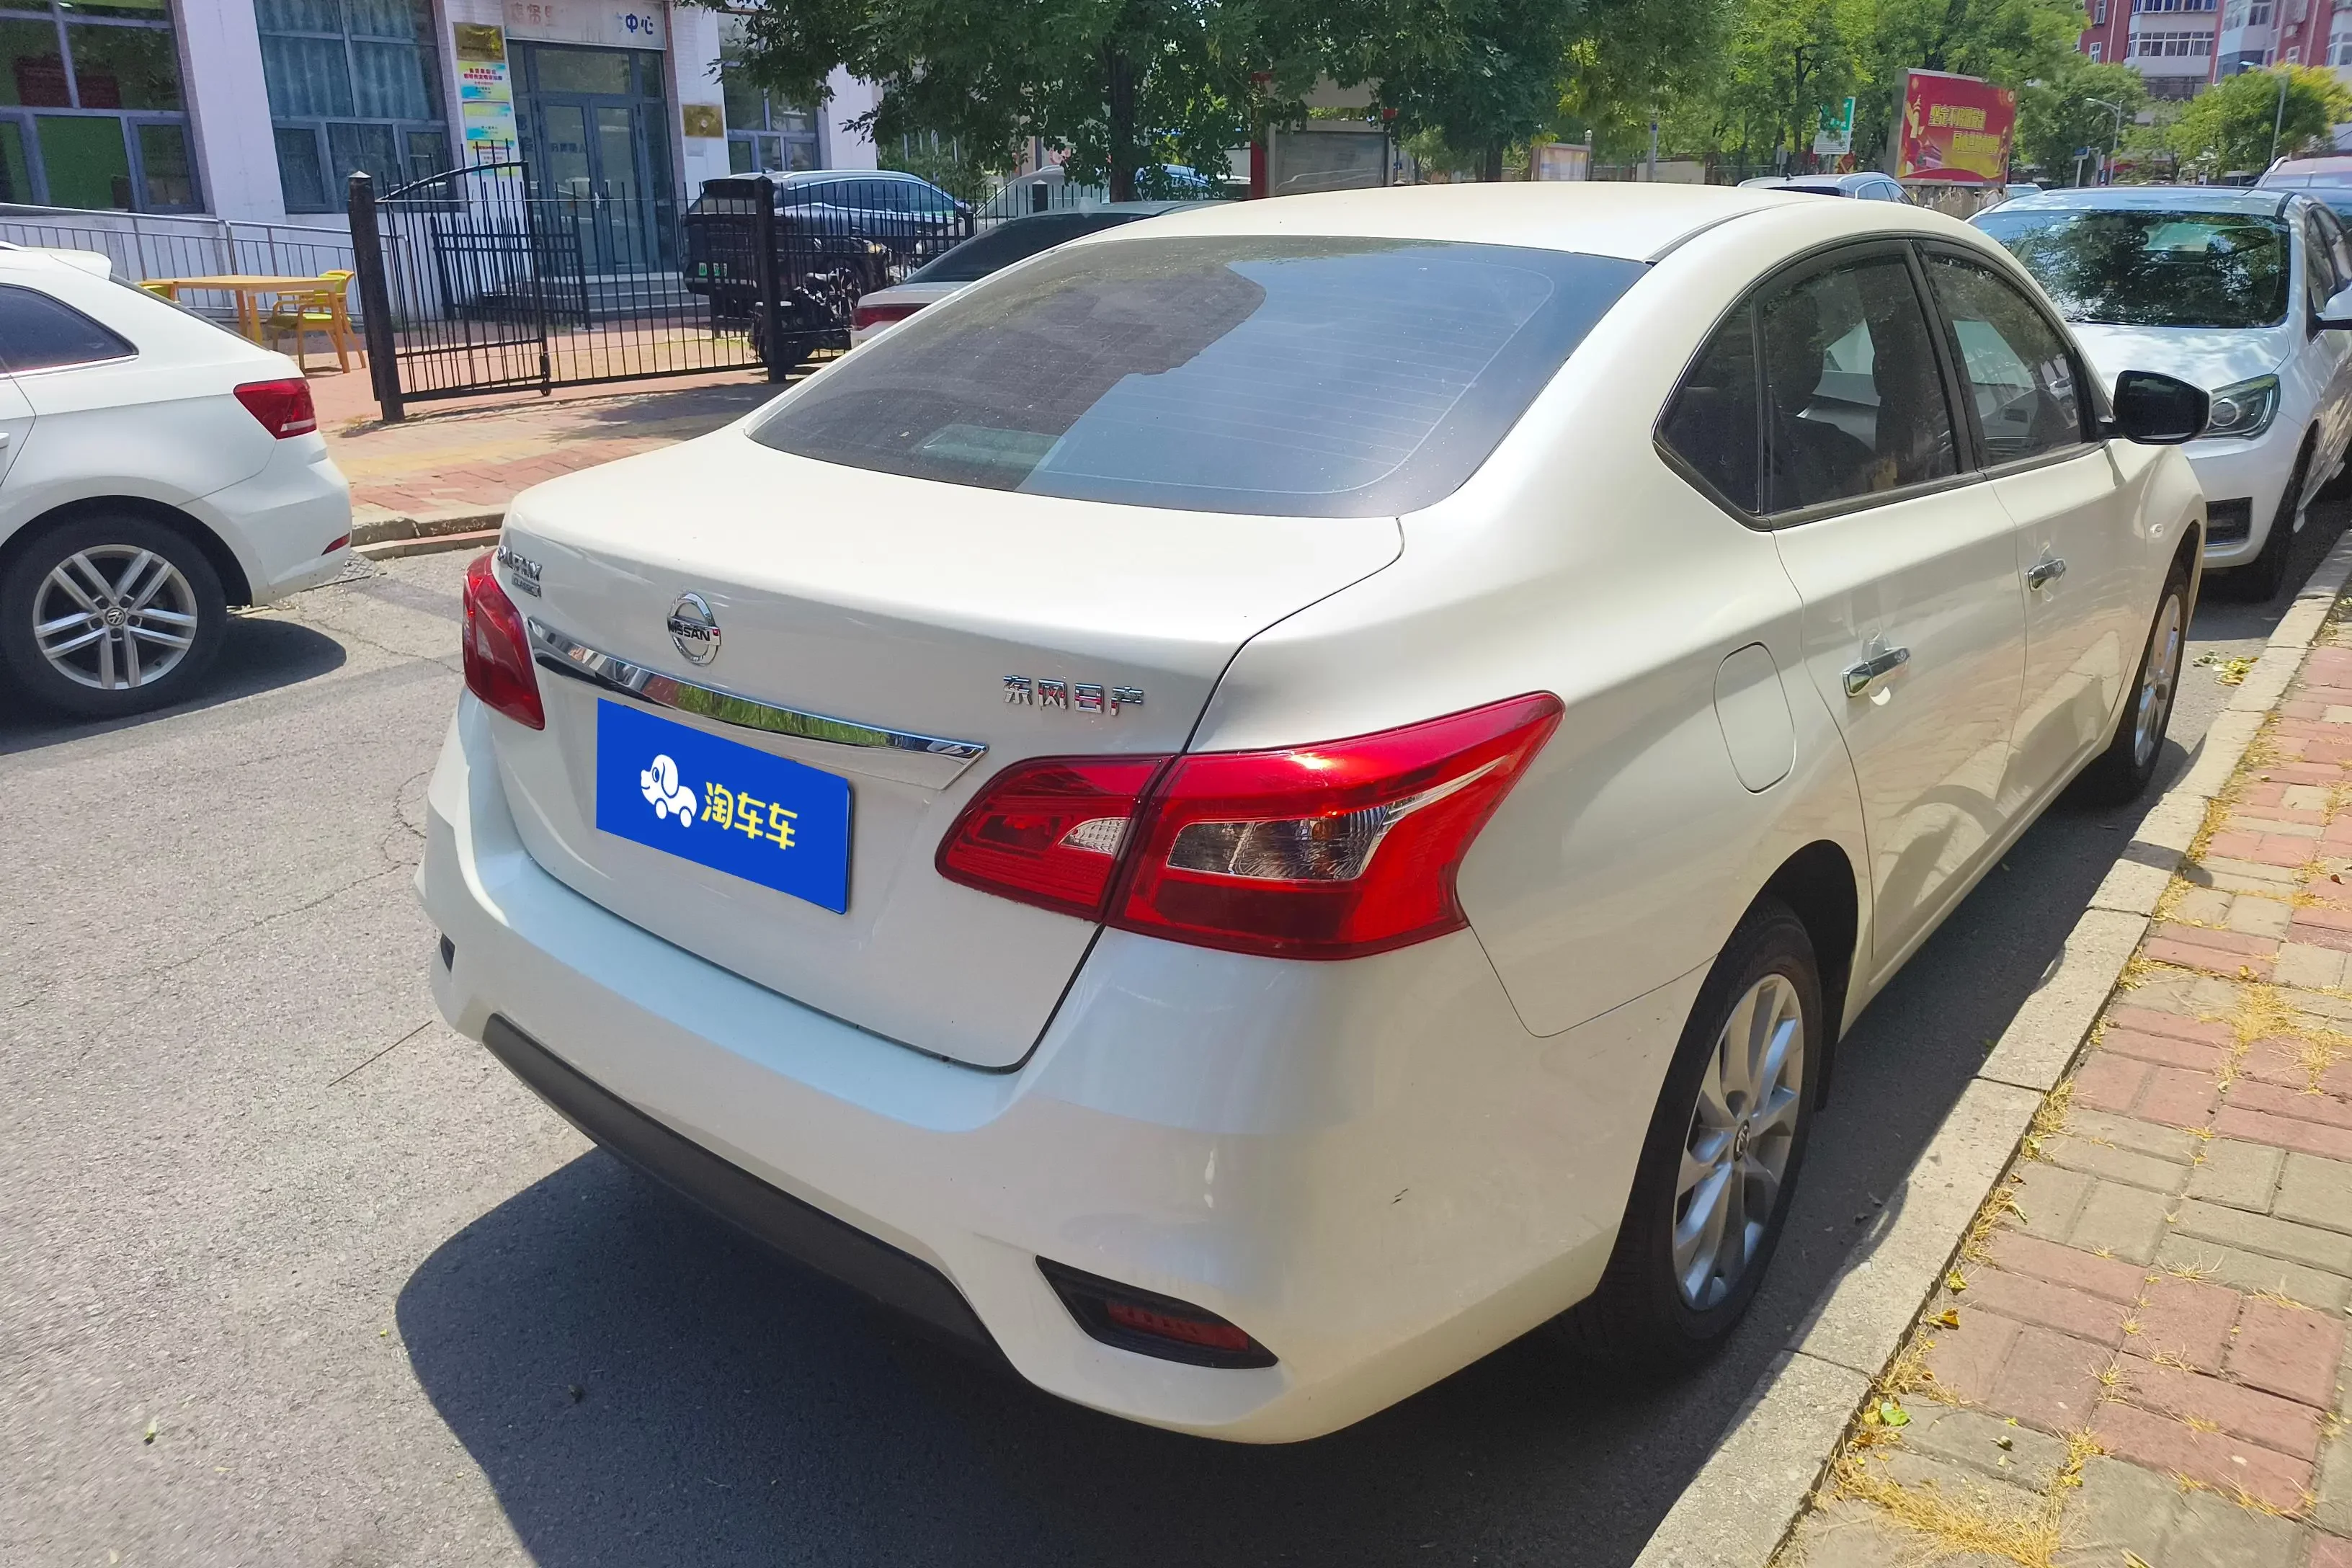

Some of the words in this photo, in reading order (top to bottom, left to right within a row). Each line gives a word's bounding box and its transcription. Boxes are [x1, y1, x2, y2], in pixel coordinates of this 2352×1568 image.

[668, 620, 710, 641] NISSAN
[1002, 675, 1144, 716] 东风日产
